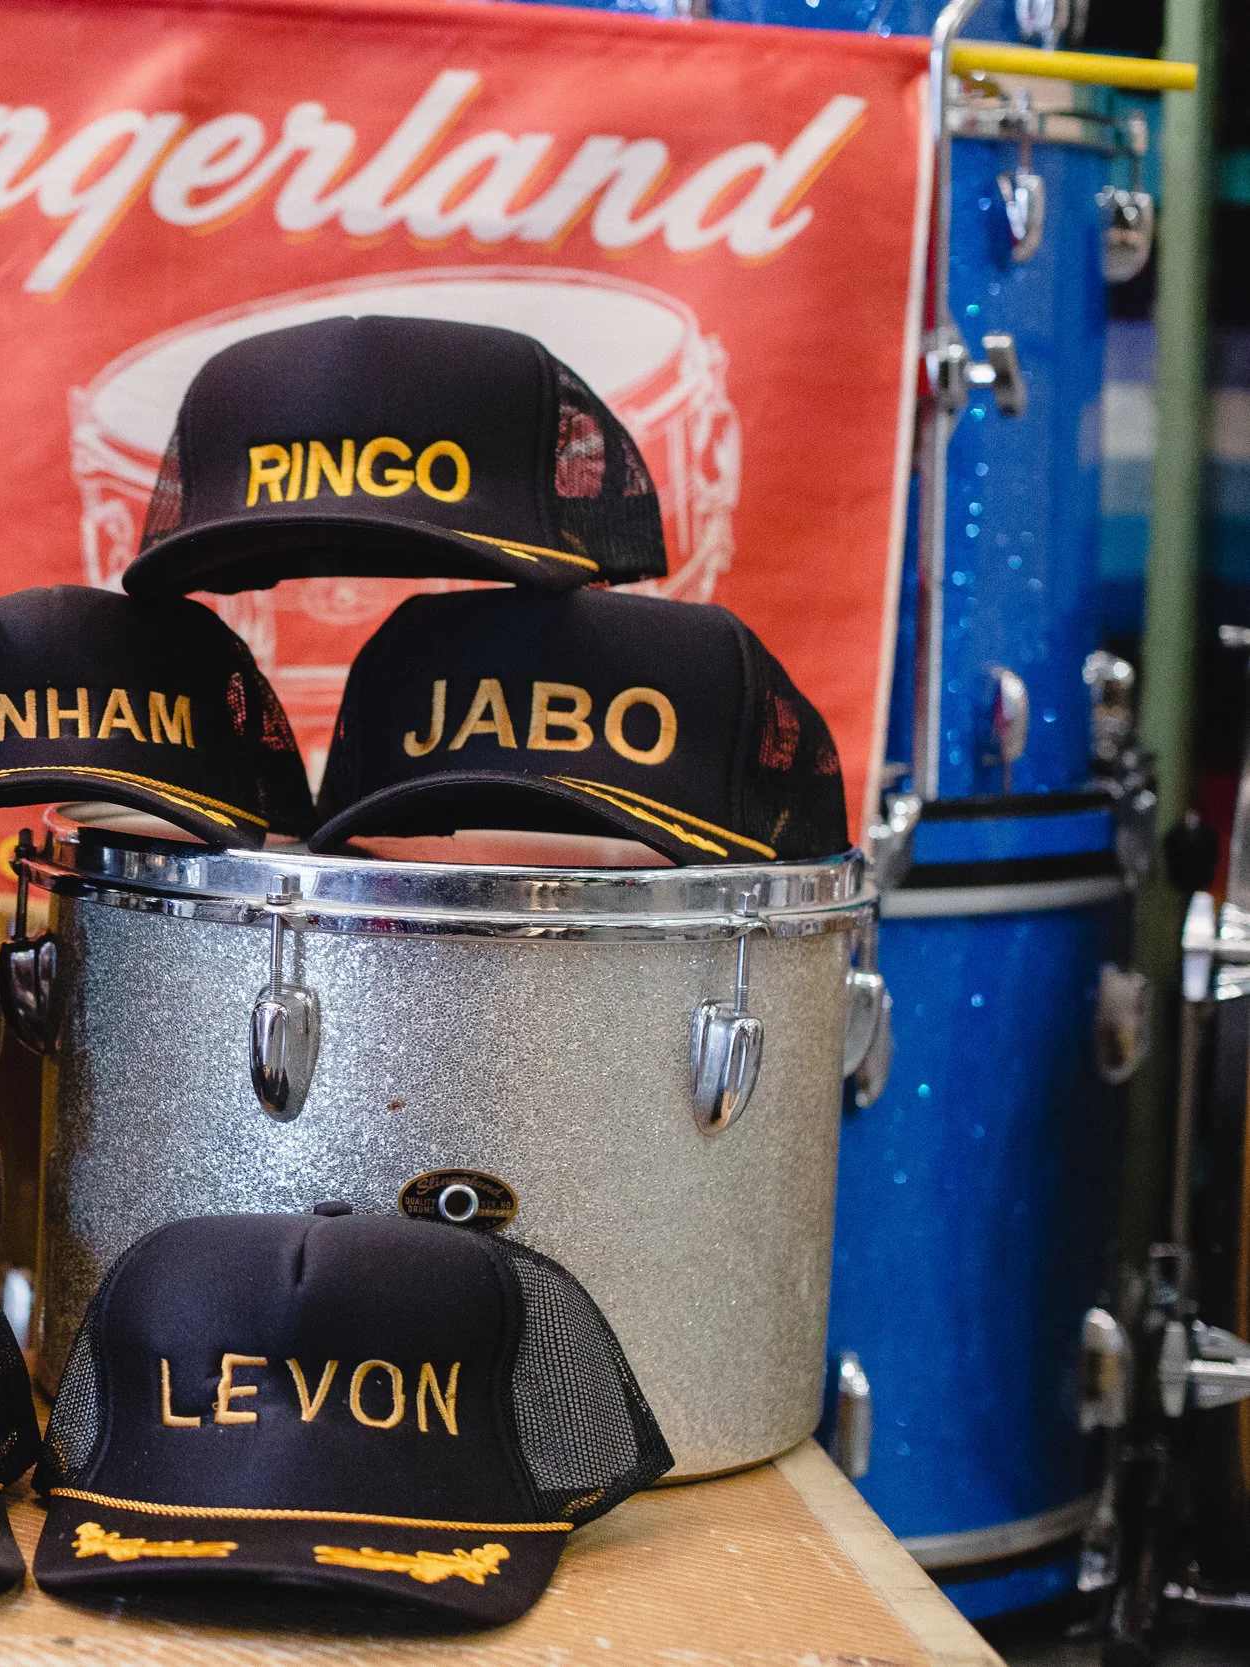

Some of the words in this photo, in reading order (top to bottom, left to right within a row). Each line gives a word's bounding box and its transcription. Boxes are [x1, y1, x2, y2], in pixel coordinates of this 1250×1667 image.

[245, 436, 471, 507] RINGO
[403, 678, 678, 766] JABO
[408, 1205, 435, 1214] DRUMS
[160, 1352, 461, 1436] LEVON
